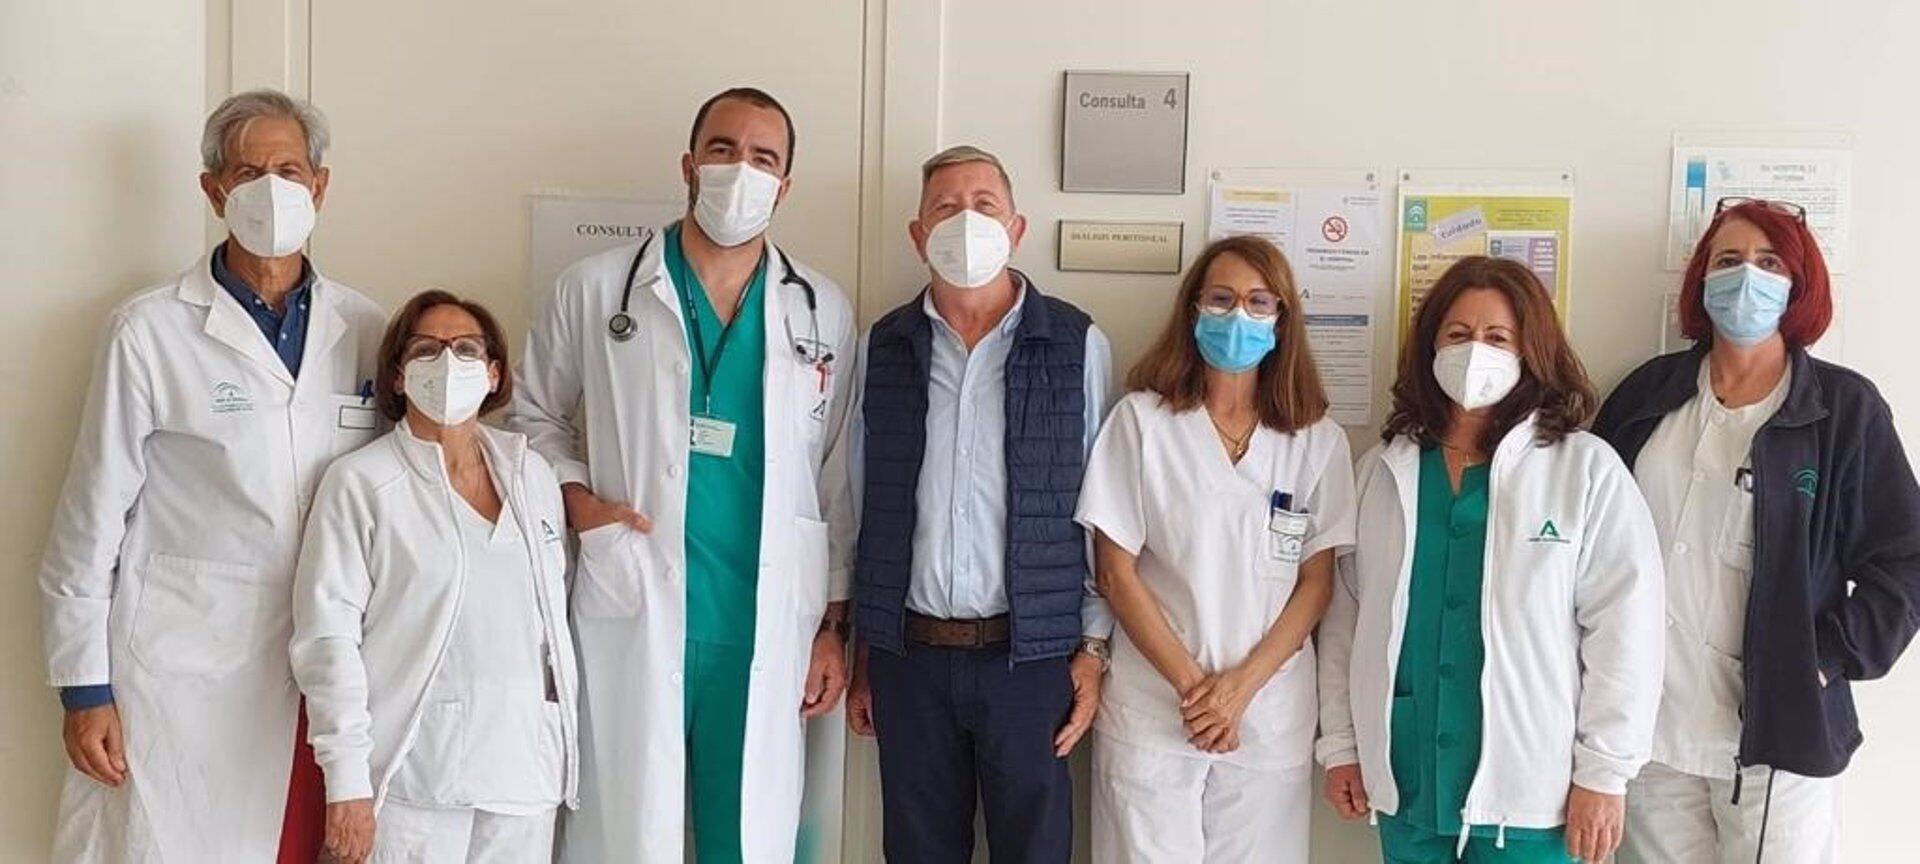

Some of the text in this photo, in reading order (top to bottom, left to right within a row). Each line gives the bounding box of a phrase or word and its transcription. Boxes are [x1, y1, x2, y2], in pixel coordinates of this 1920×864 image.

[1080, 88, 1177, 109] Consulta 4
[576, 224, 654, 237] CONSULTA
